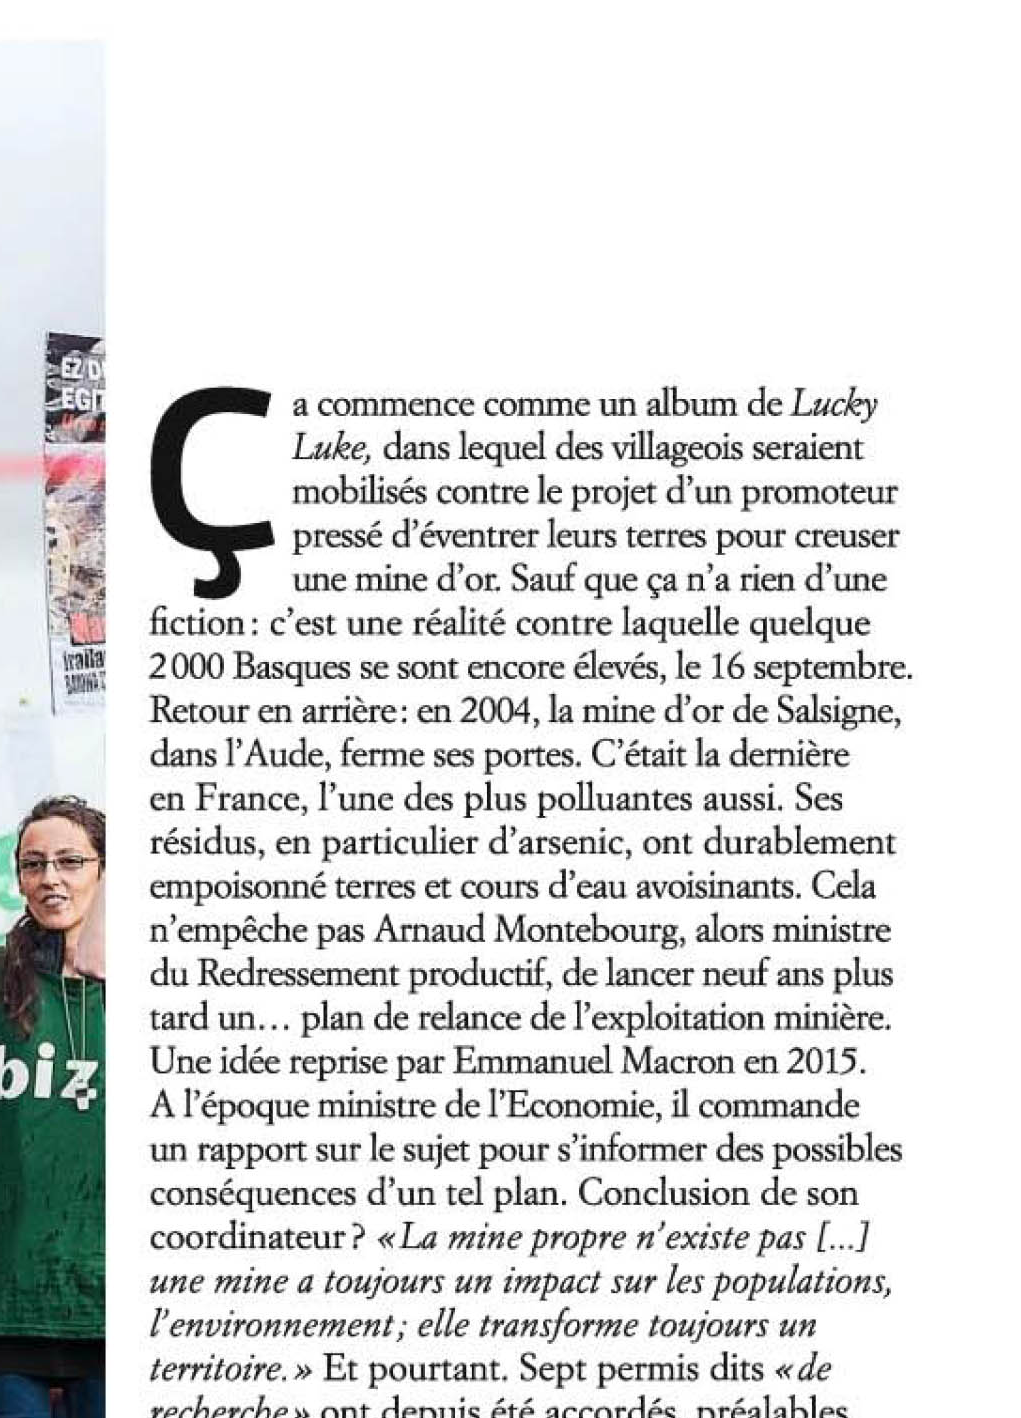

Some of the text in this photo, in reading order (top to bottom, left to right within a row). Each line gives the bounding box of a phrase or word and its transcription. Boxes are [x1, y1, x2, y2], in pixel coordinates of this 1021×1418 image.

[292, 385, 879, 424] a commence comme un album de Lucky
[150, 386, 275, 599] Ç
[150, 824, 897, 862] résidus, en particulier d'arsenic, ont durablement
[150, 911, 892, 951] n'empêche pas Arnaud Montebourg, alors ministre
[150, 1087, 860, 1126] A l'époque ministre de l'Economie, il commande
